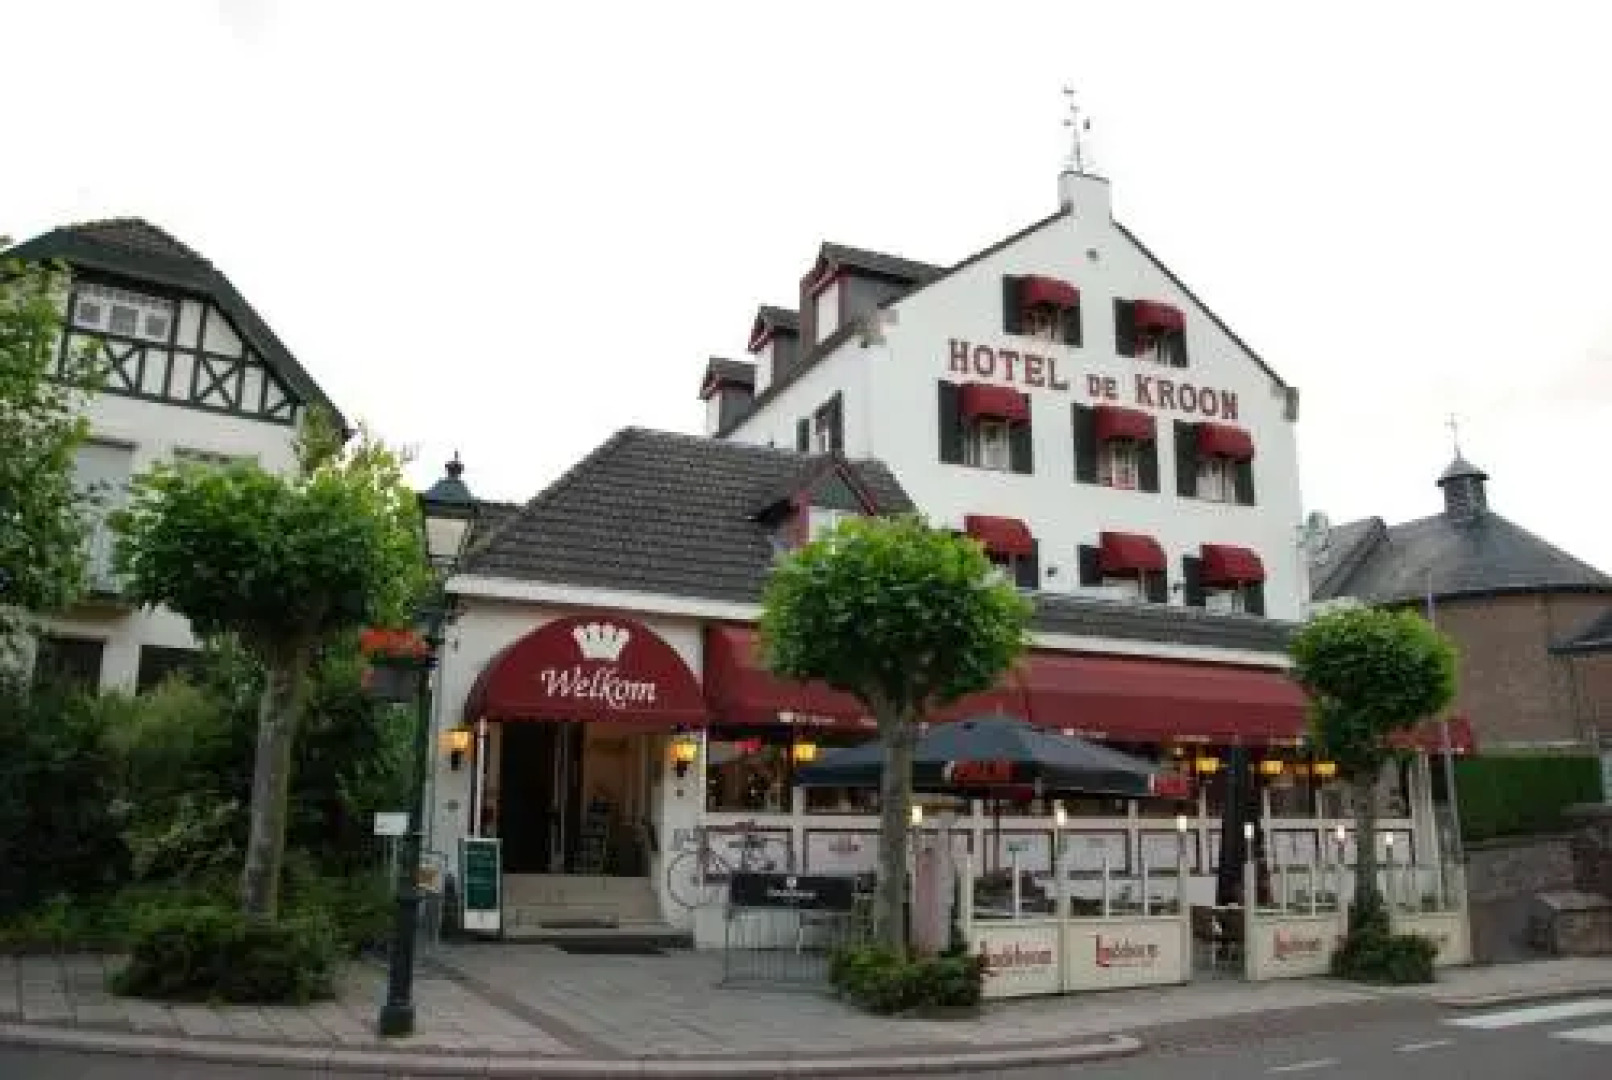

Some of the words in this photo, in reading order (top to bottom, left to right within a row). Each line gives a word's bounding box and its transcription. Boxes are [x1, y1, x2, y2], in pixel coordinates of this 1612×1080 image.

[948, 338, 1069, 390] HOTEL
[1087, 373, 1118, 400] DE
[1135, 373, 1238, 419] KROON
[541, 665, 655, 710] Welkom
